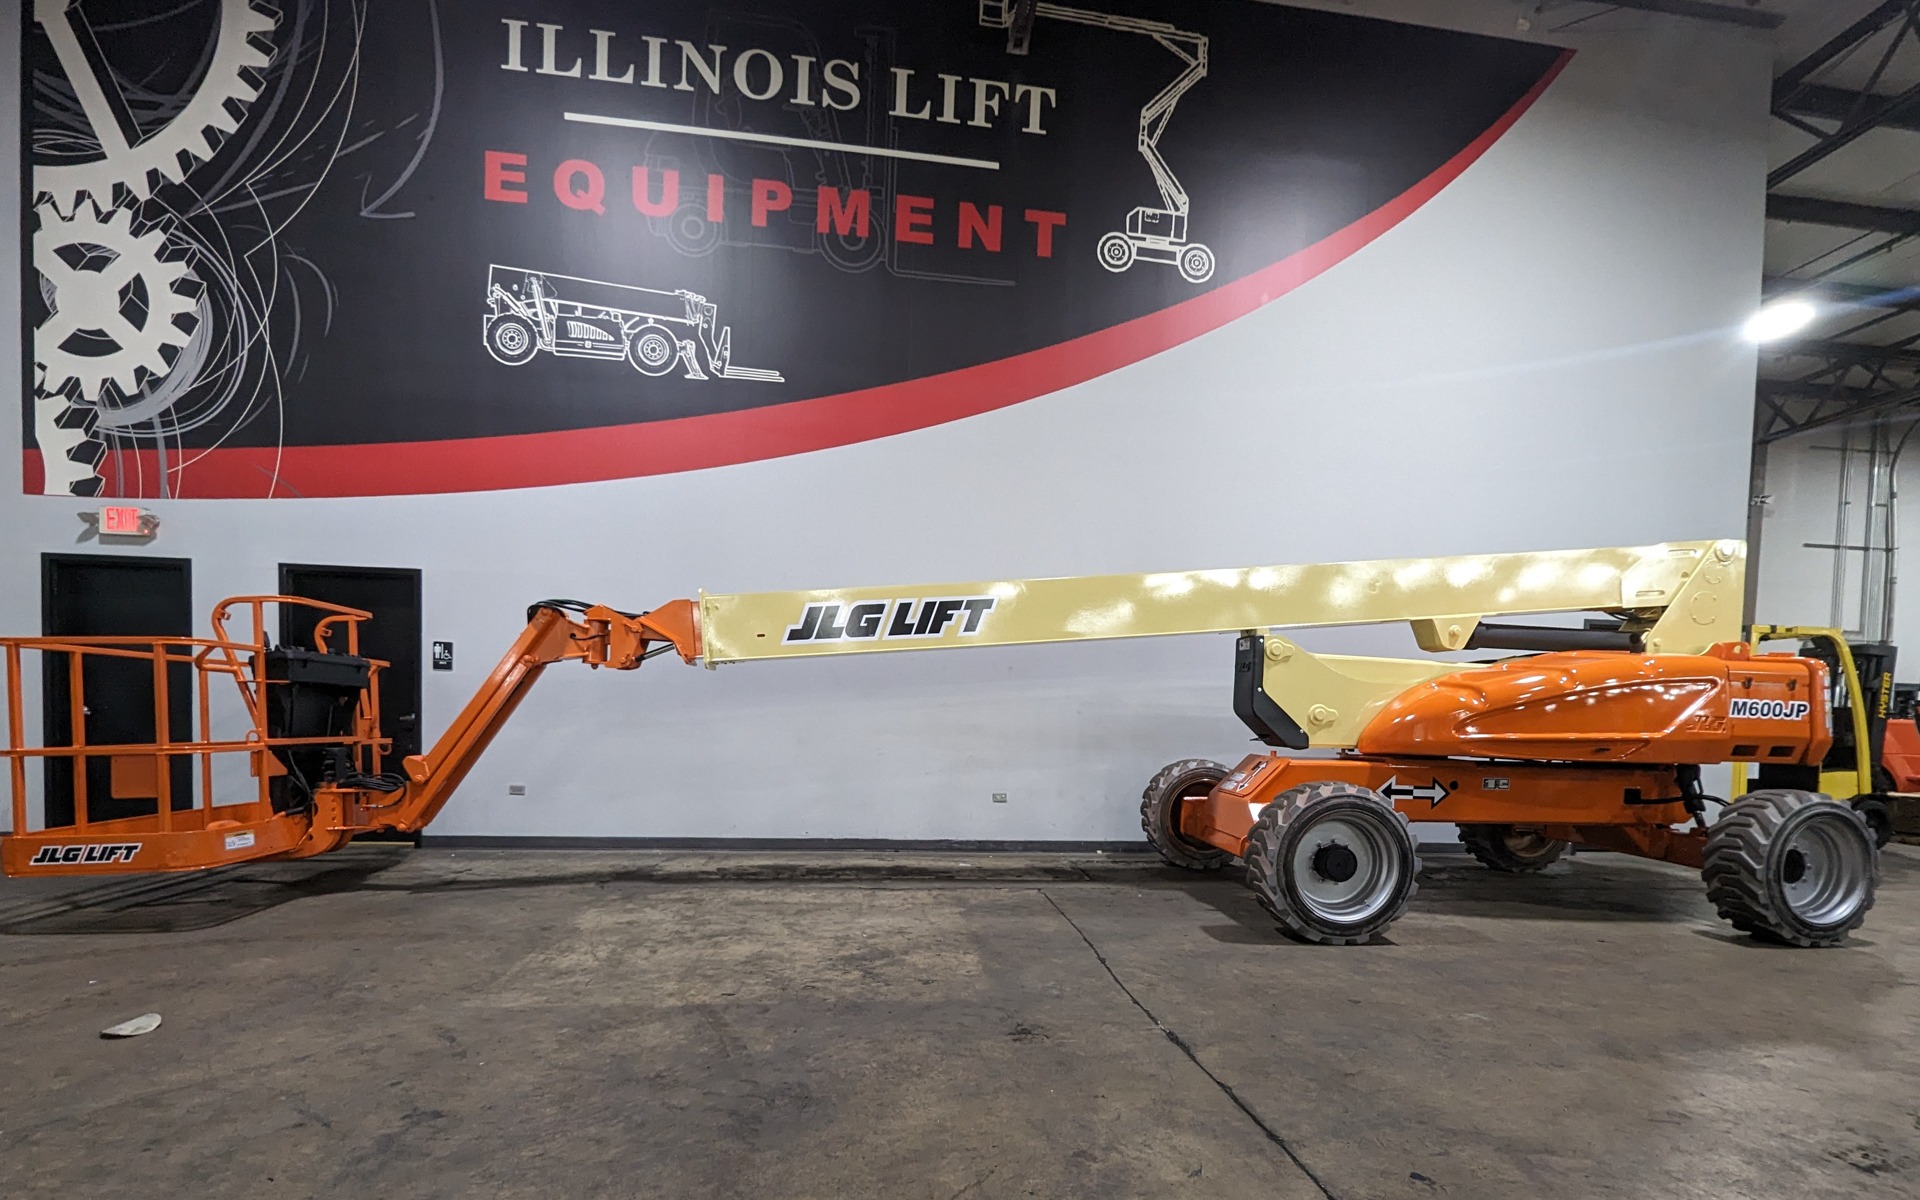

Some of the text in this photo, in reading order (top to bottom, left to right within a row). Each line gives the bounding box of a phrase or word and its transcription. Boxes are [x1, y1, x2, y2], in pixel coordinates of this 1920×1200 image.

[500, 18, 1057, 136] ILLINOIS LIFT
[484, 150, 1067, 258] EQUIPMENT
[106, 507, 138, 531] EXIT
[785, 598, 995, 641] JLG LIFT
[1731, 700, 1808, 718] M600JP
[1877, 671, 1892, 719] HYSTER
[32, 844, 140, 863] JLG LIFT
